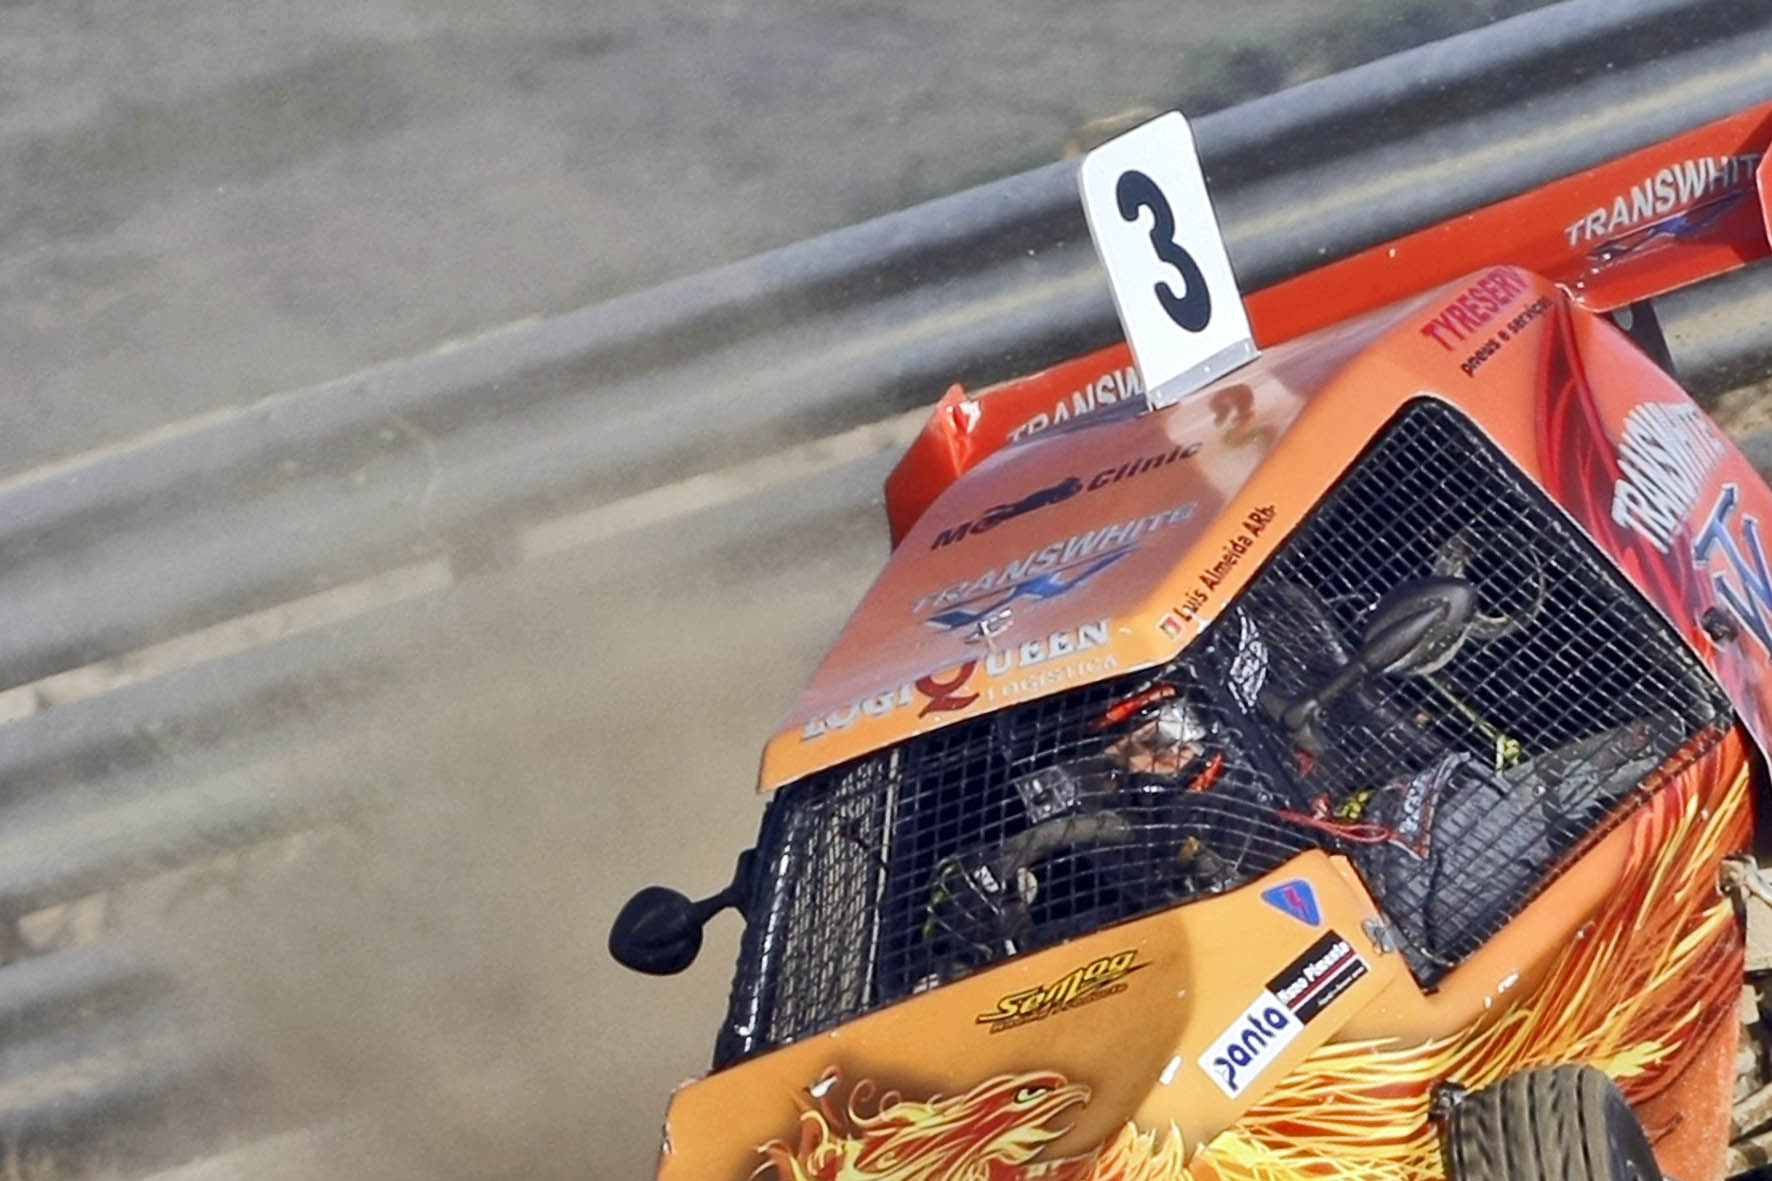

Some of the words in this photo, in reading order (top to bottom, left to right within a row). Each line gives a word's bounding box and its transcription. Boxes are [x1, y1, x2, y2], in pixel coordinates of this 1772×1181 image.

[1564, 154, 1758, 246] TRANSWHIT
[1116, 169, 1212, 333] 3
[1460, 338, 1501, 378] pneus
[1498, 329, 1510, 342] e
[1006, 365, 1146, 444] TRANSW
[912, 501, 1198, 613] TRANSWHITE
[1172, 589, 1208, 622] Luis
[1198, 534, 1254, 592] Almeida
